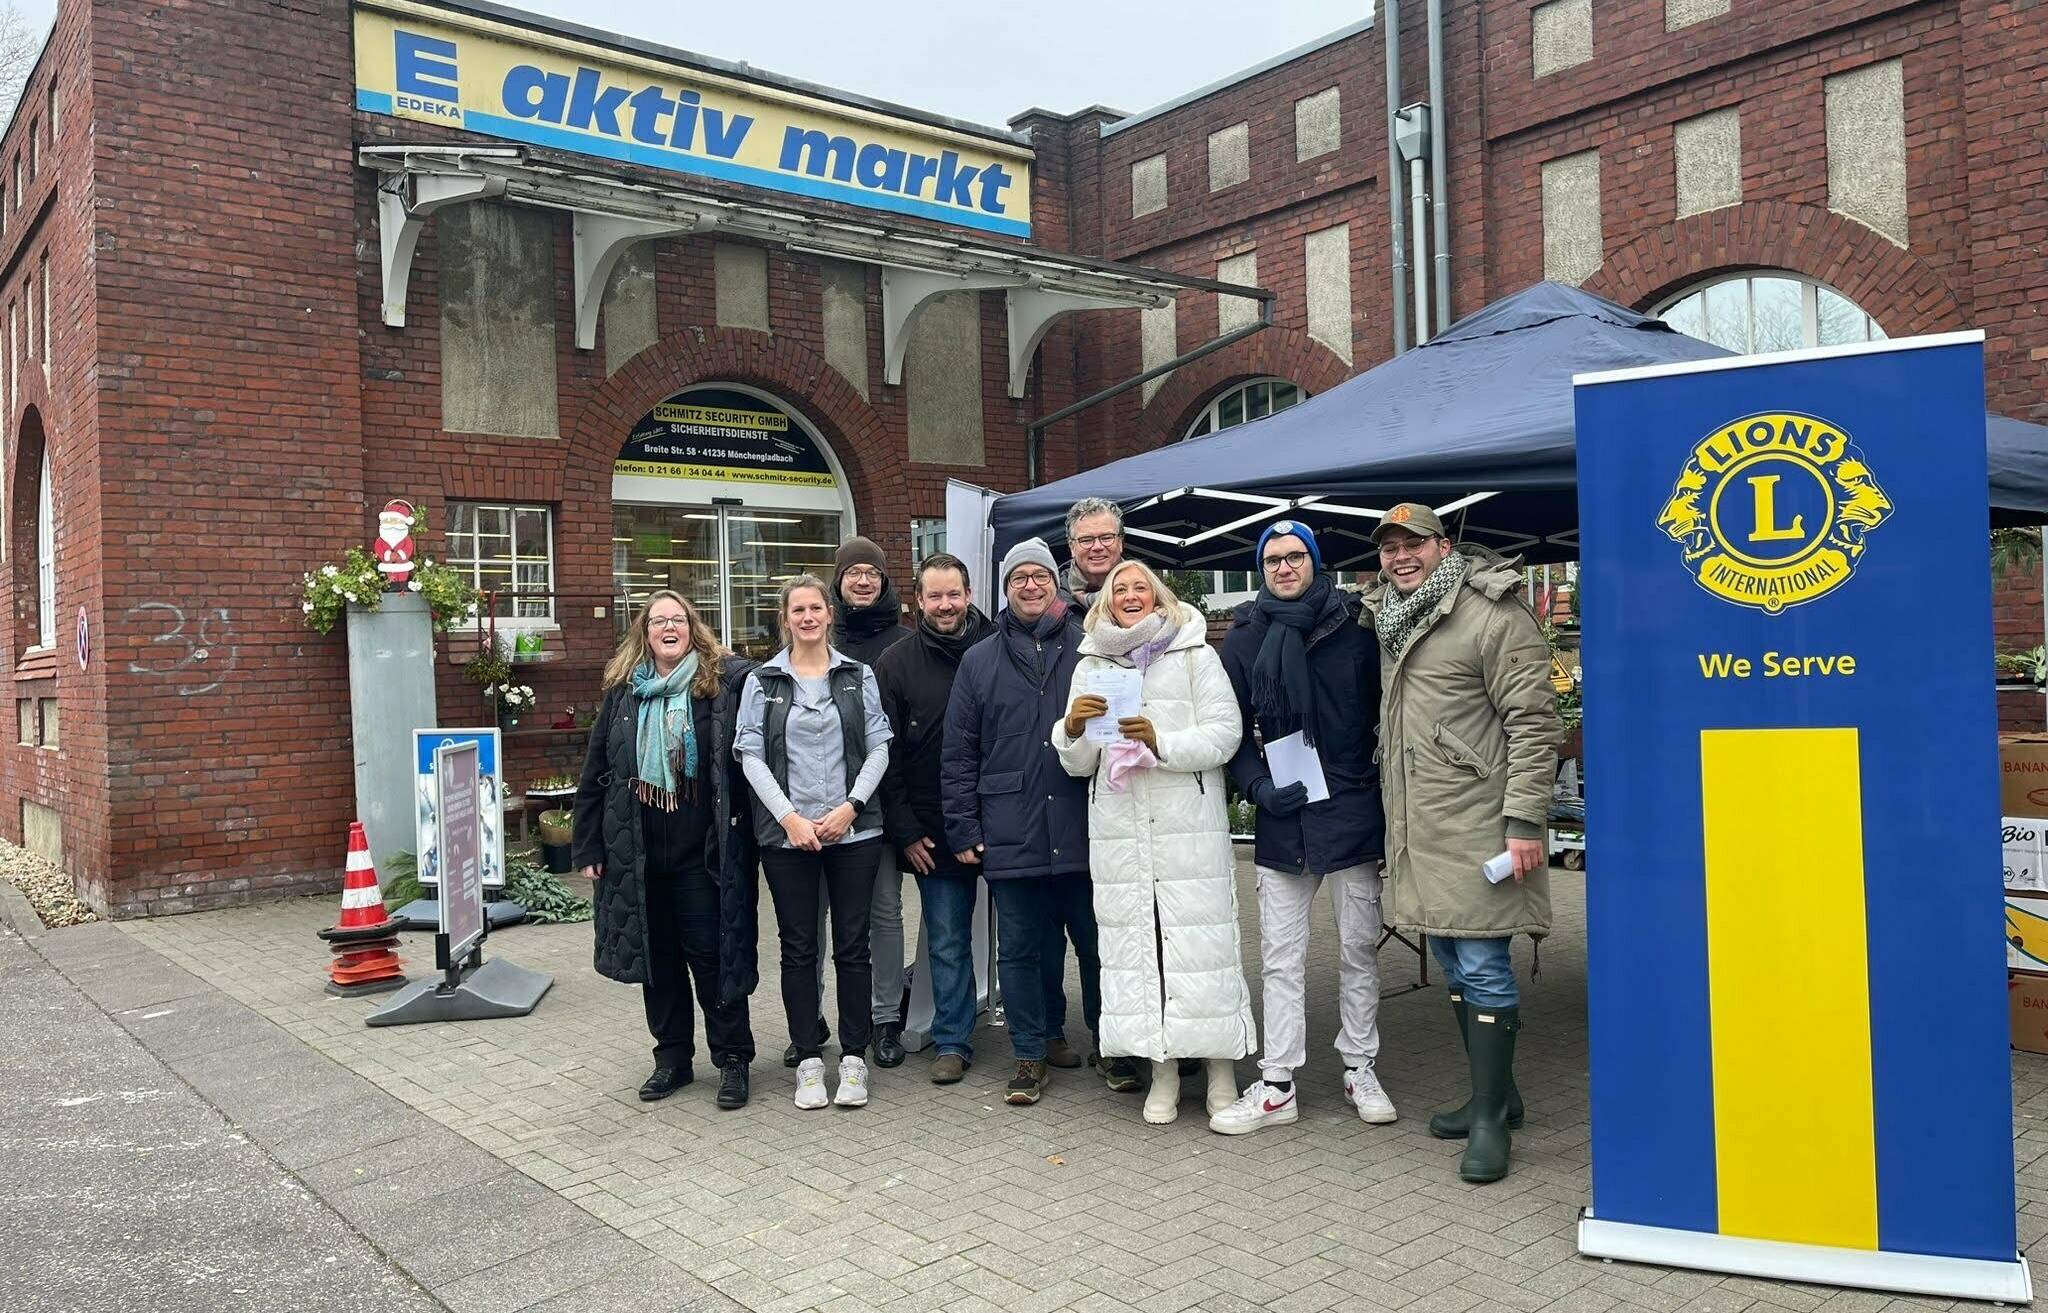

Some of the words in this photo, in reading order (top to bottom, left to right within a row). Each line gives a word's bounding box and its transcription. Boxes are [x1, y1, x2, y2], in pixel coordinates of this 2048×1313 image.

[394, 30, 459, 101] E
[397, 96, 462, 119] EDEKA
[502, 64, 755, 159] aktiv
[777, 127, 1012, 215] markt
[655, 407, 702, 420] SCHMITZ
[705, 411, 755, 425] SECURITY
[757, 415, 787, 428] GMBH
[670, 423, 769, 440] SICHERHEITSDIENSTE
[1704, 420, 1838, 466] LIONS
[644, 443, 669, 454] Breite
[671, 446, 685, 455] Str.
[686, 447, 696, 456] 58
[702, 448, 726, 458] 41236
[727, 449, 793, 463] Mönchengladbach
[648, 465, 654, 473] 0
[656, 466, 667, 474] 21
[670, 467, 681, 475] 66
[689, 468, 700, 476] 34
[701, 468, 713, 477] 04
[714, 469, 725, 477] 44
[731, 471, 832, 486] www.schmitz-security.de
[1747, 475, 1805, 542] L
[1709, 558, 1840, 596] INTERNATIONAL
[1698, 653, 1751, 679] We
[1762, 652, 1856, 677] Serve
[2001, 825, 2035, 844] Bio
